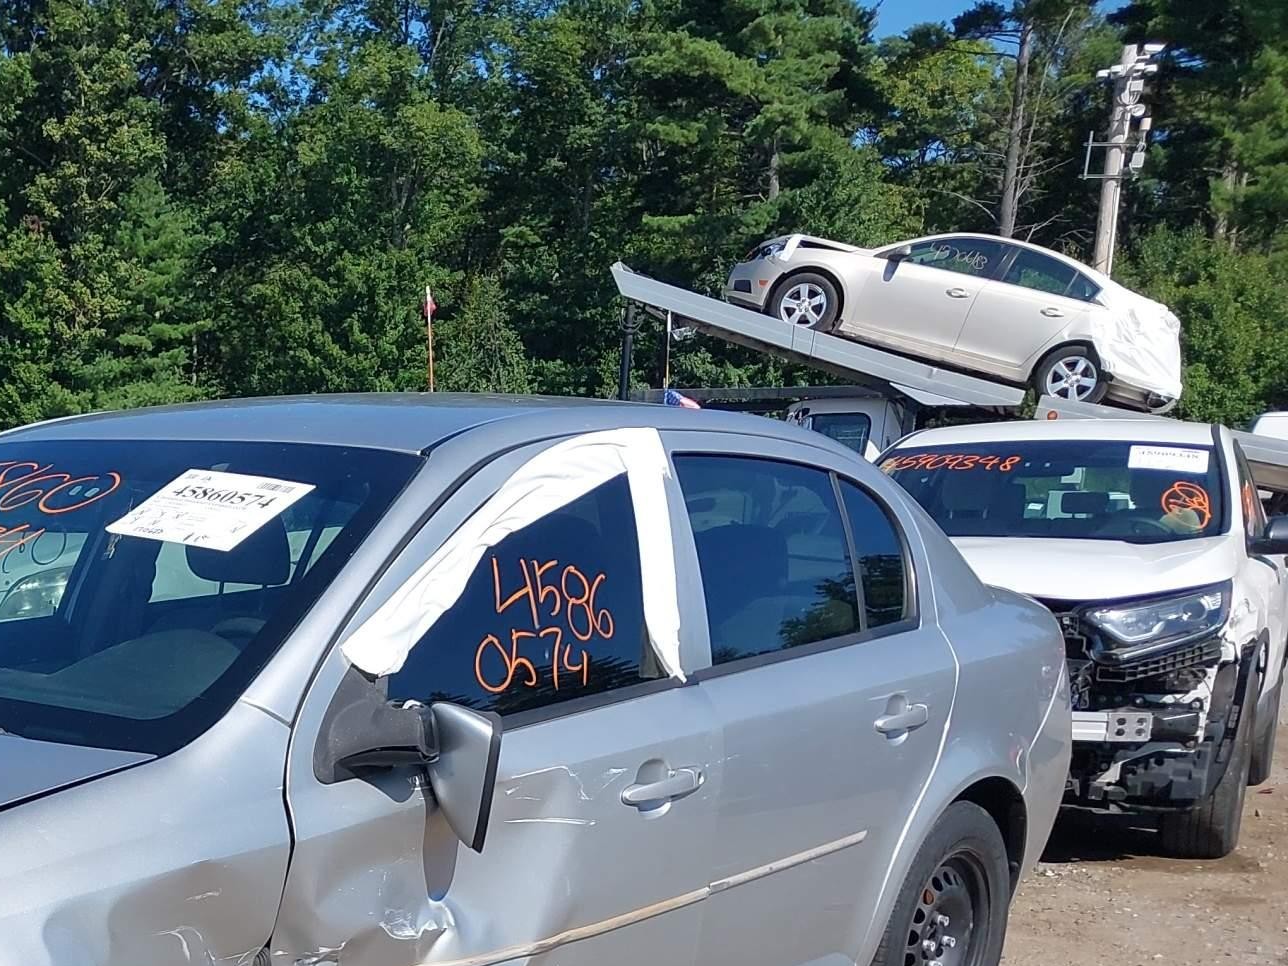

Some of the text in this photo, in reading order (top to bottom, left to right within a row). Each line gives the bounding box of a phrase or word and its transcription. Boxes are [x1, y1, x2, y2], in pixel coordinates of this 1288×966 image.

[172, 484, 279, 509] 45860574
[491, 556, 614, 641] 4586
[475, 628, 589, 694] 0574
